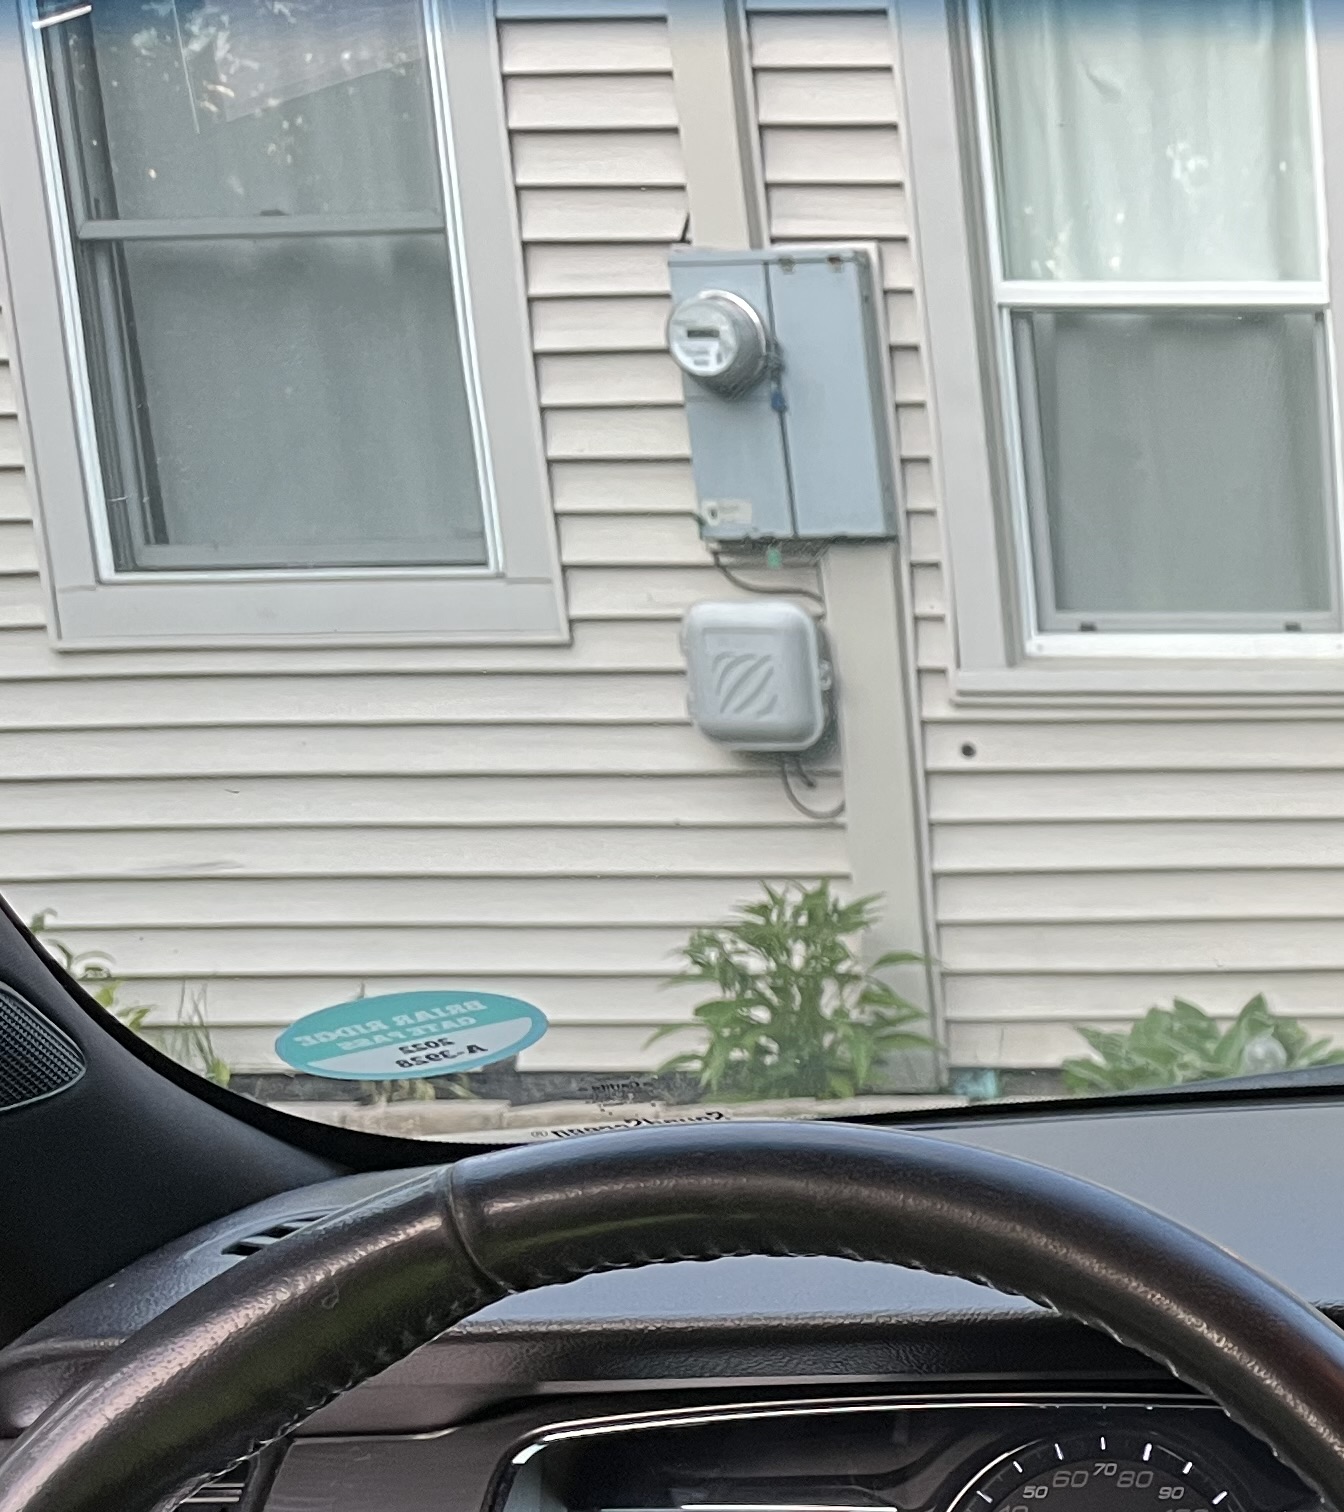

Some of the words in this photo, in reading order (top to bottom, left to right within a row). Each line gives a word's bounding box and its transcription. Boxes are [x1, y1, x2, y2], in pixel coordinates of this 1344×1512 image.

[1093, 1463, 1118, 1476] 70
[1052, 1470, 1089, 1488] 60
[1116, 1470, 1154, 1488] 80
[1023, 1485, 1049, 1499] 50
[1158, 1486, 1185, 1500] 90
